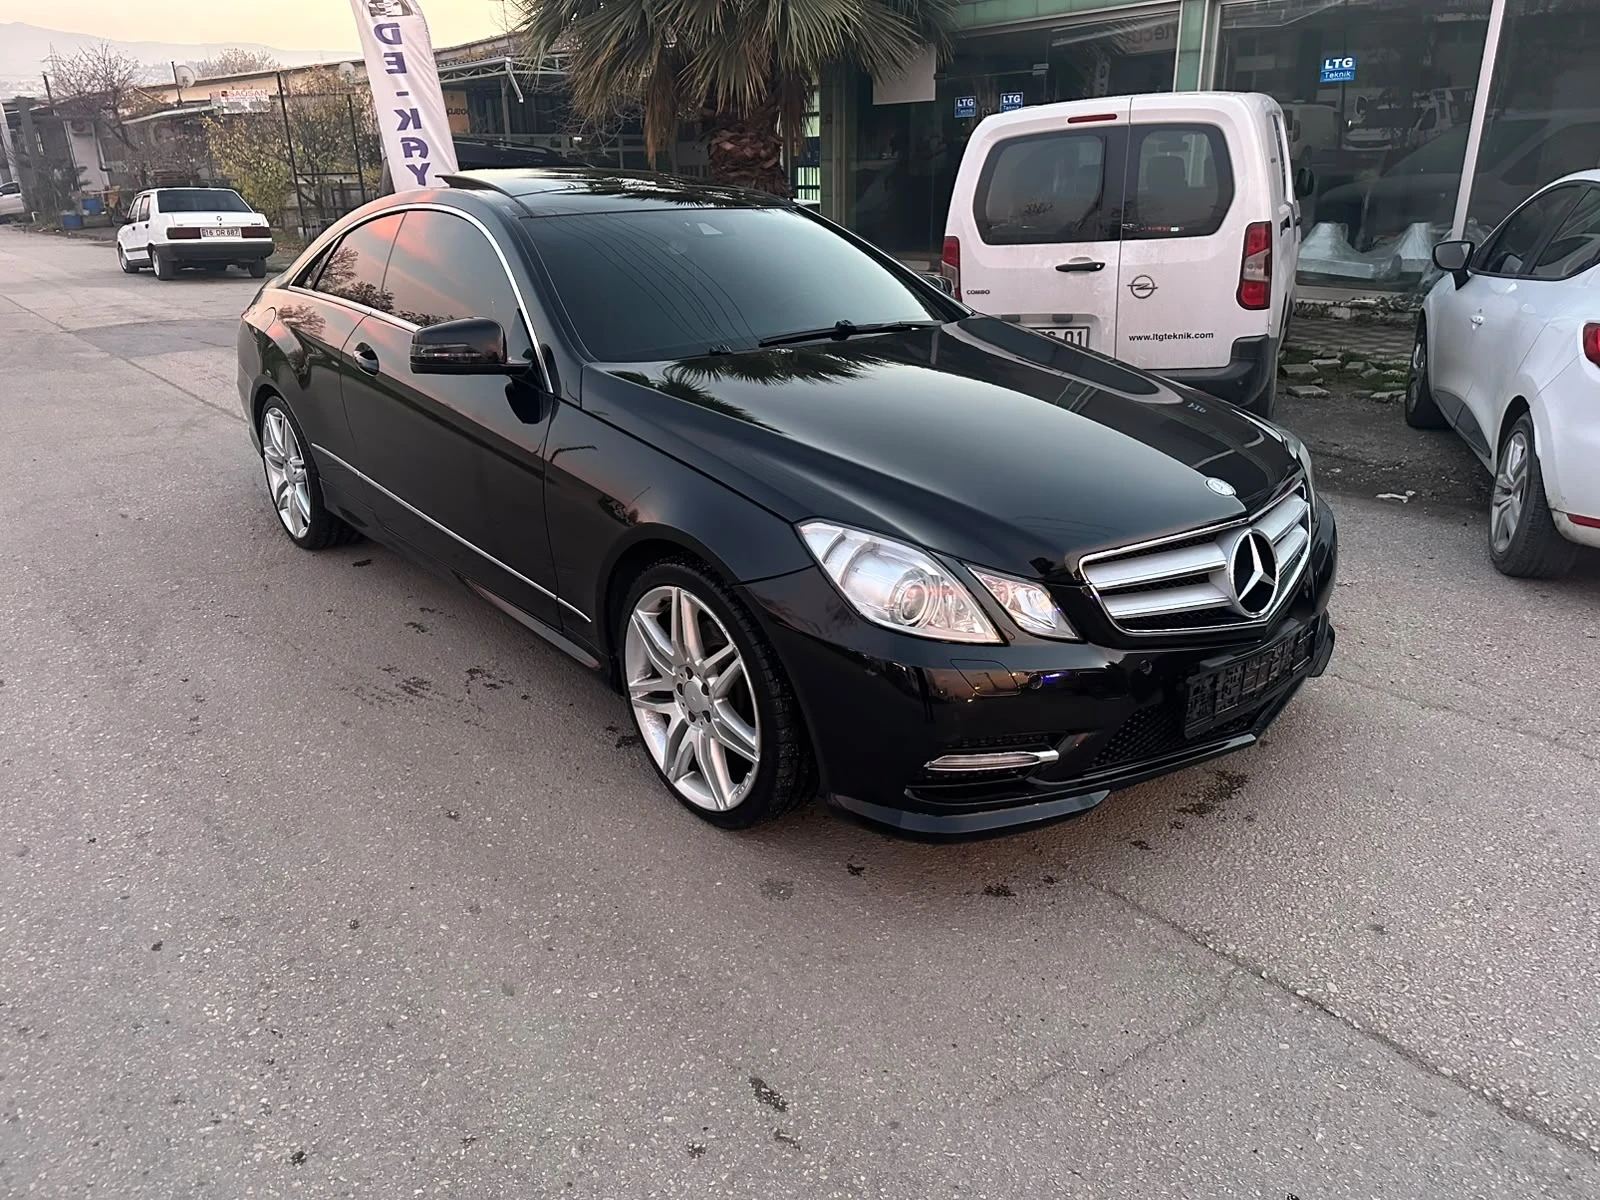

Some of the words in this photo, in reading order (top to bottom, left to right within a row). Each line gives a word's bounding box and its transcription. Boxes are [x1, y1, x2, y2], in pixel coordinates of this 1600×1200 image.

[1324, 57, 1354, 70] LTG
[1324, 70, 1351, 79] Teknik
[957, 98, 974, 107] LTG
[1003, 94, 1021, 104] LTG
[1128, 332, 1214, 342] www.ltgteknik.com
